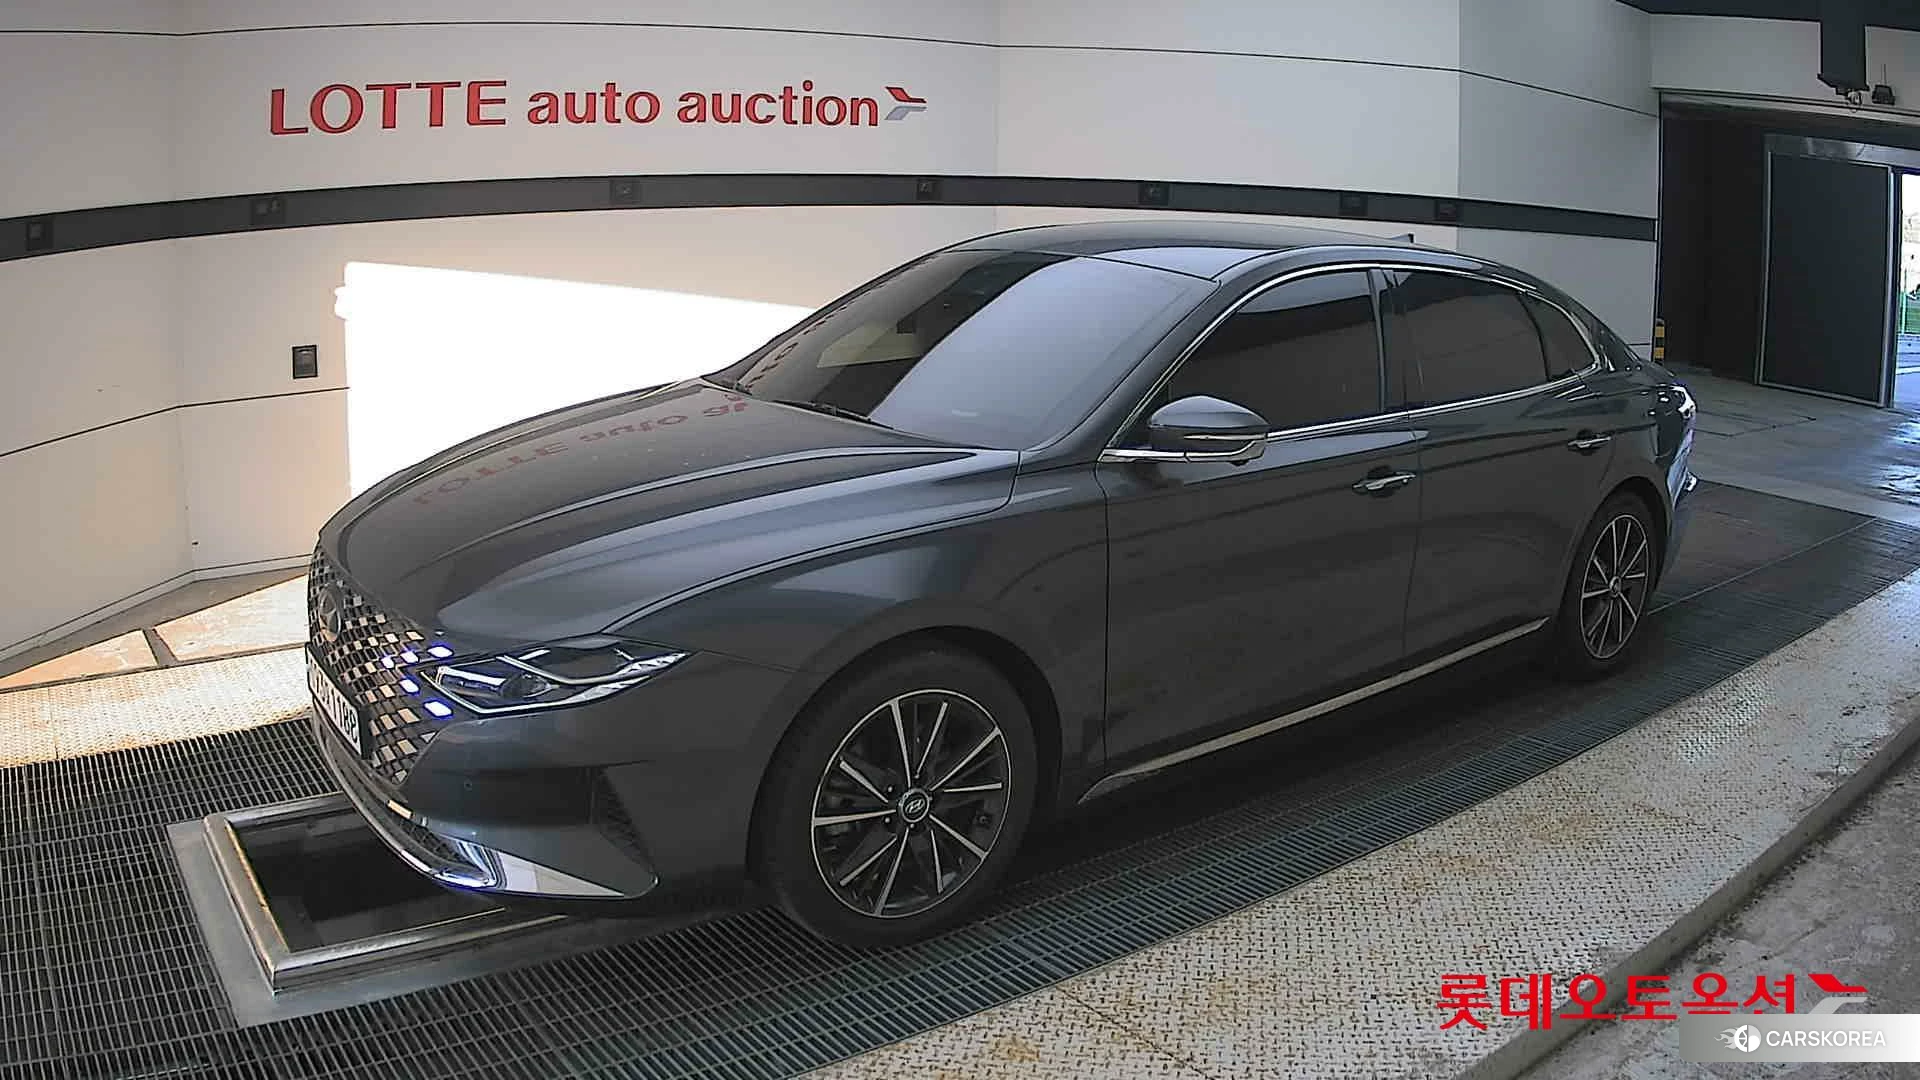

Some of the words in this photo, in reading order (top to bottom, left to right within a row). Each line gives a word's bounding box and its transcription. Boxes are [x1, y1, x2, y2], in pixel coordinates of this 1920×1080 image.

[269, 80, 507, 136] LOTTE
[527, 82, 662, 125] auto
[677, 80, 879, 127] auction
